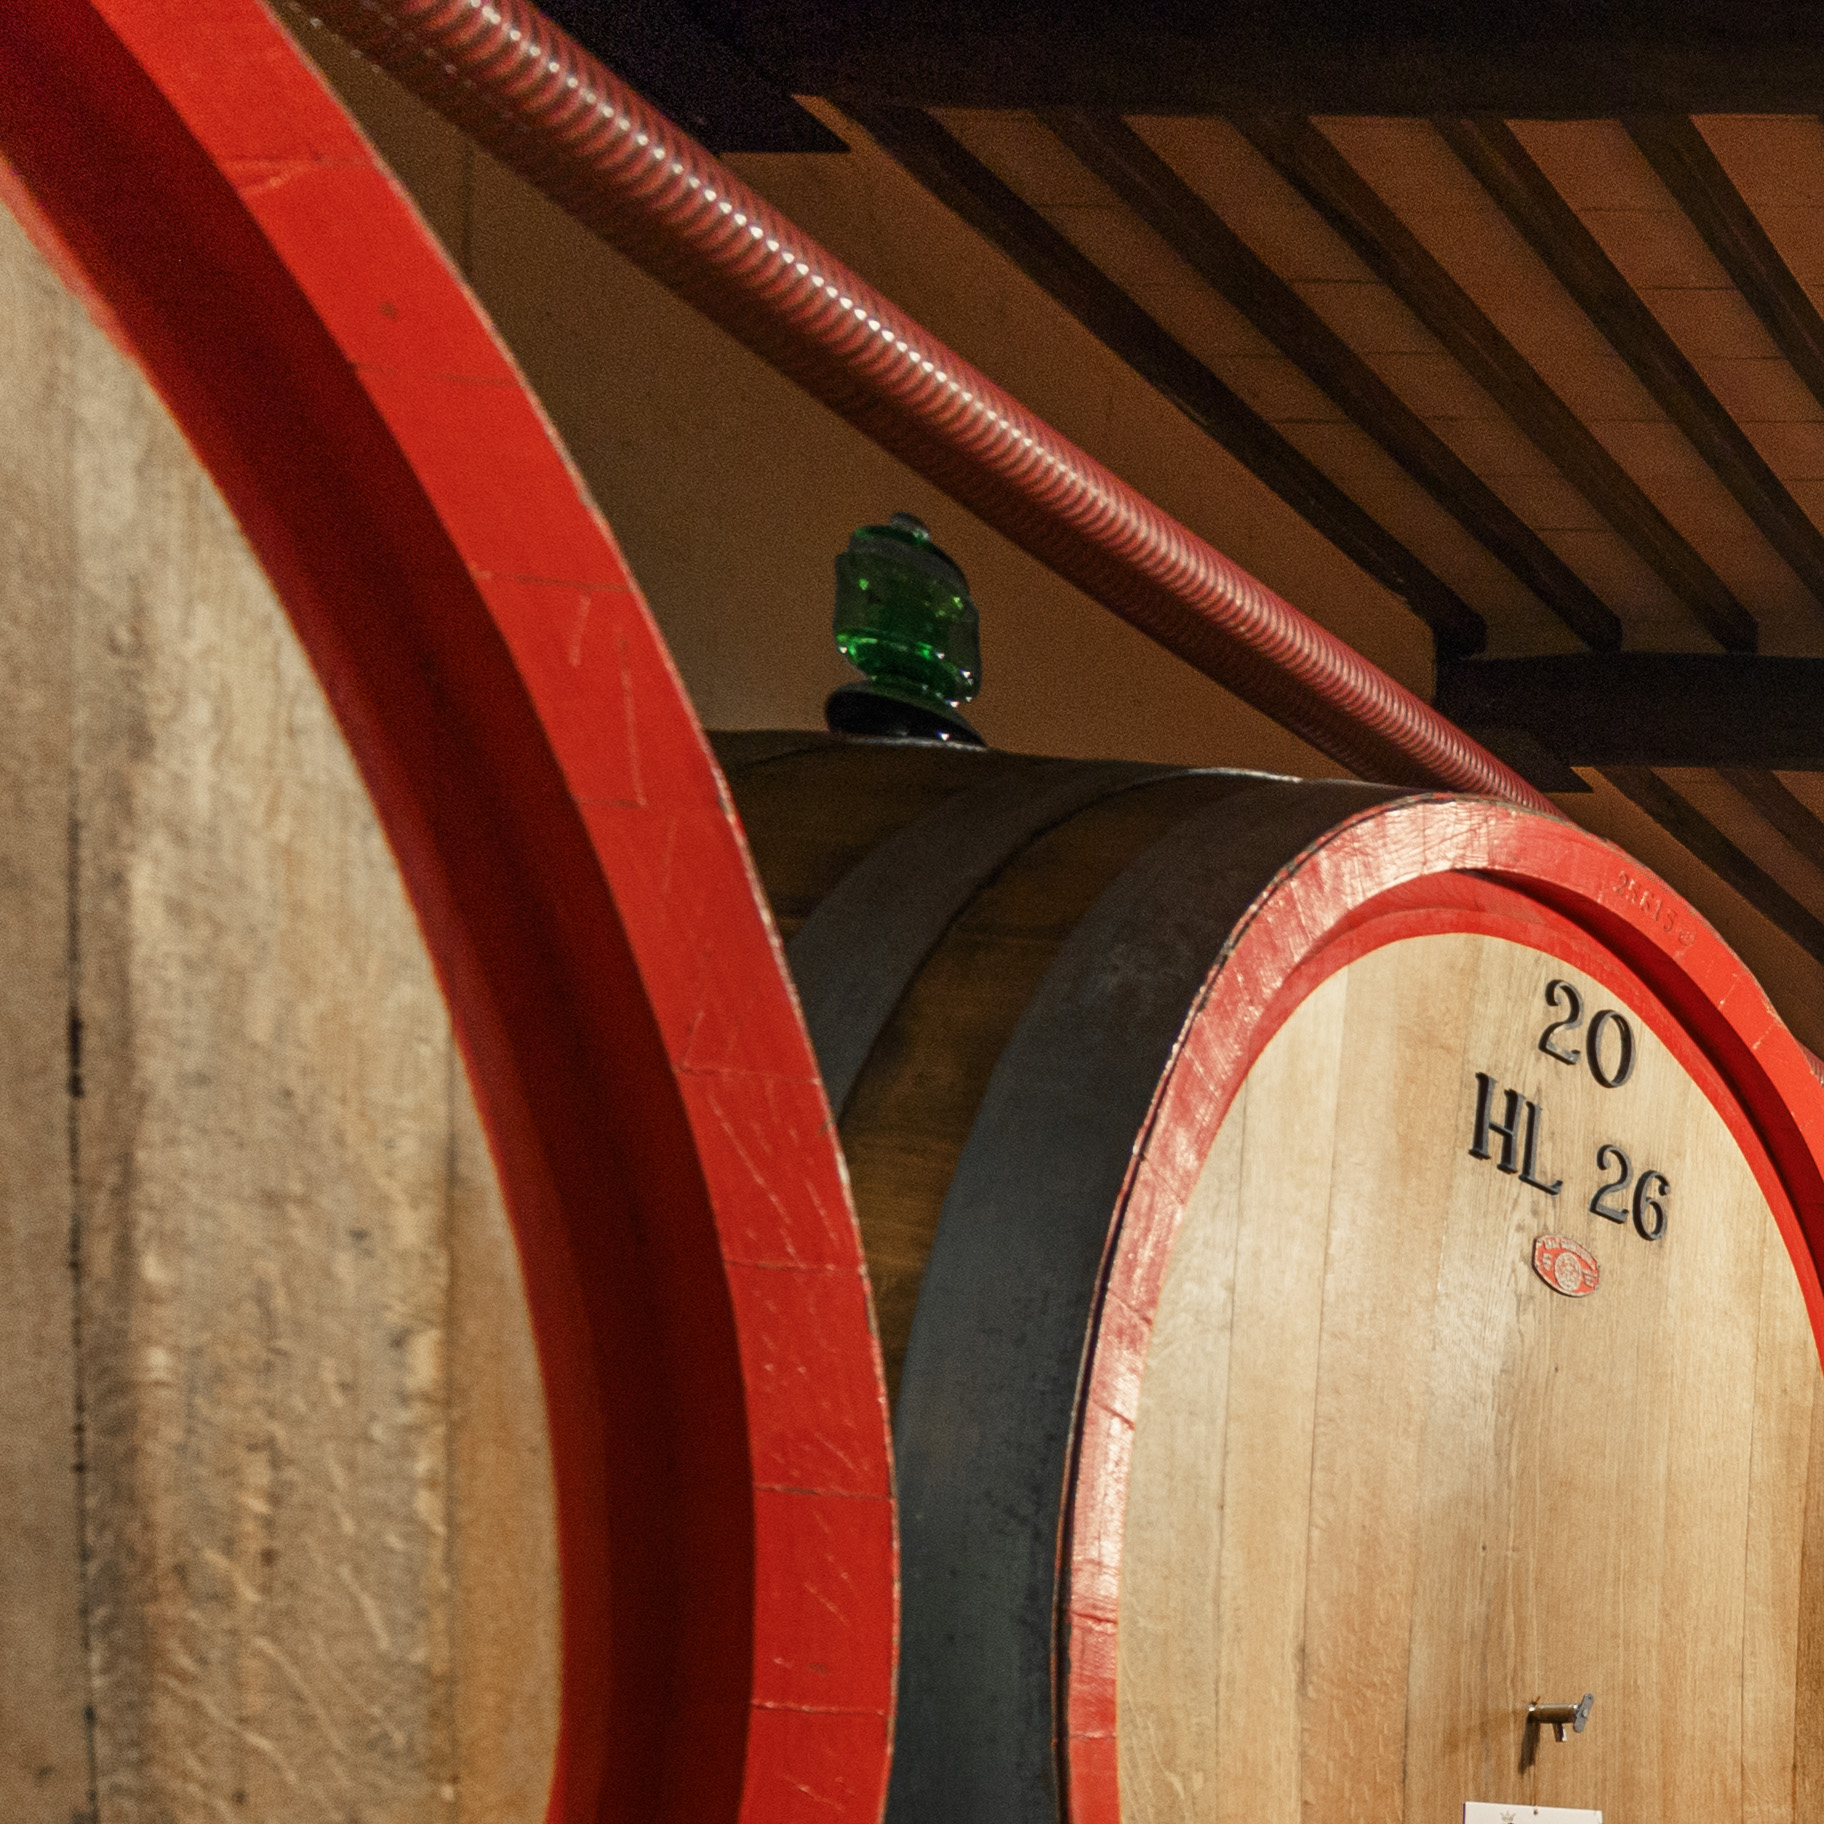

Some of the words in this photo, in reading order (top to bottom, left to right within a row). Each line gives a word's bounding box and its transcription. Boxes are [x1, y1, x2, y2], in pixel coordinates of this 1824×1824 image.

[1538, 978, 1636, 1088] 20
[1468, 1071, 1563, 1196] HL
[1589, 1143, 1670, 1241] 26
